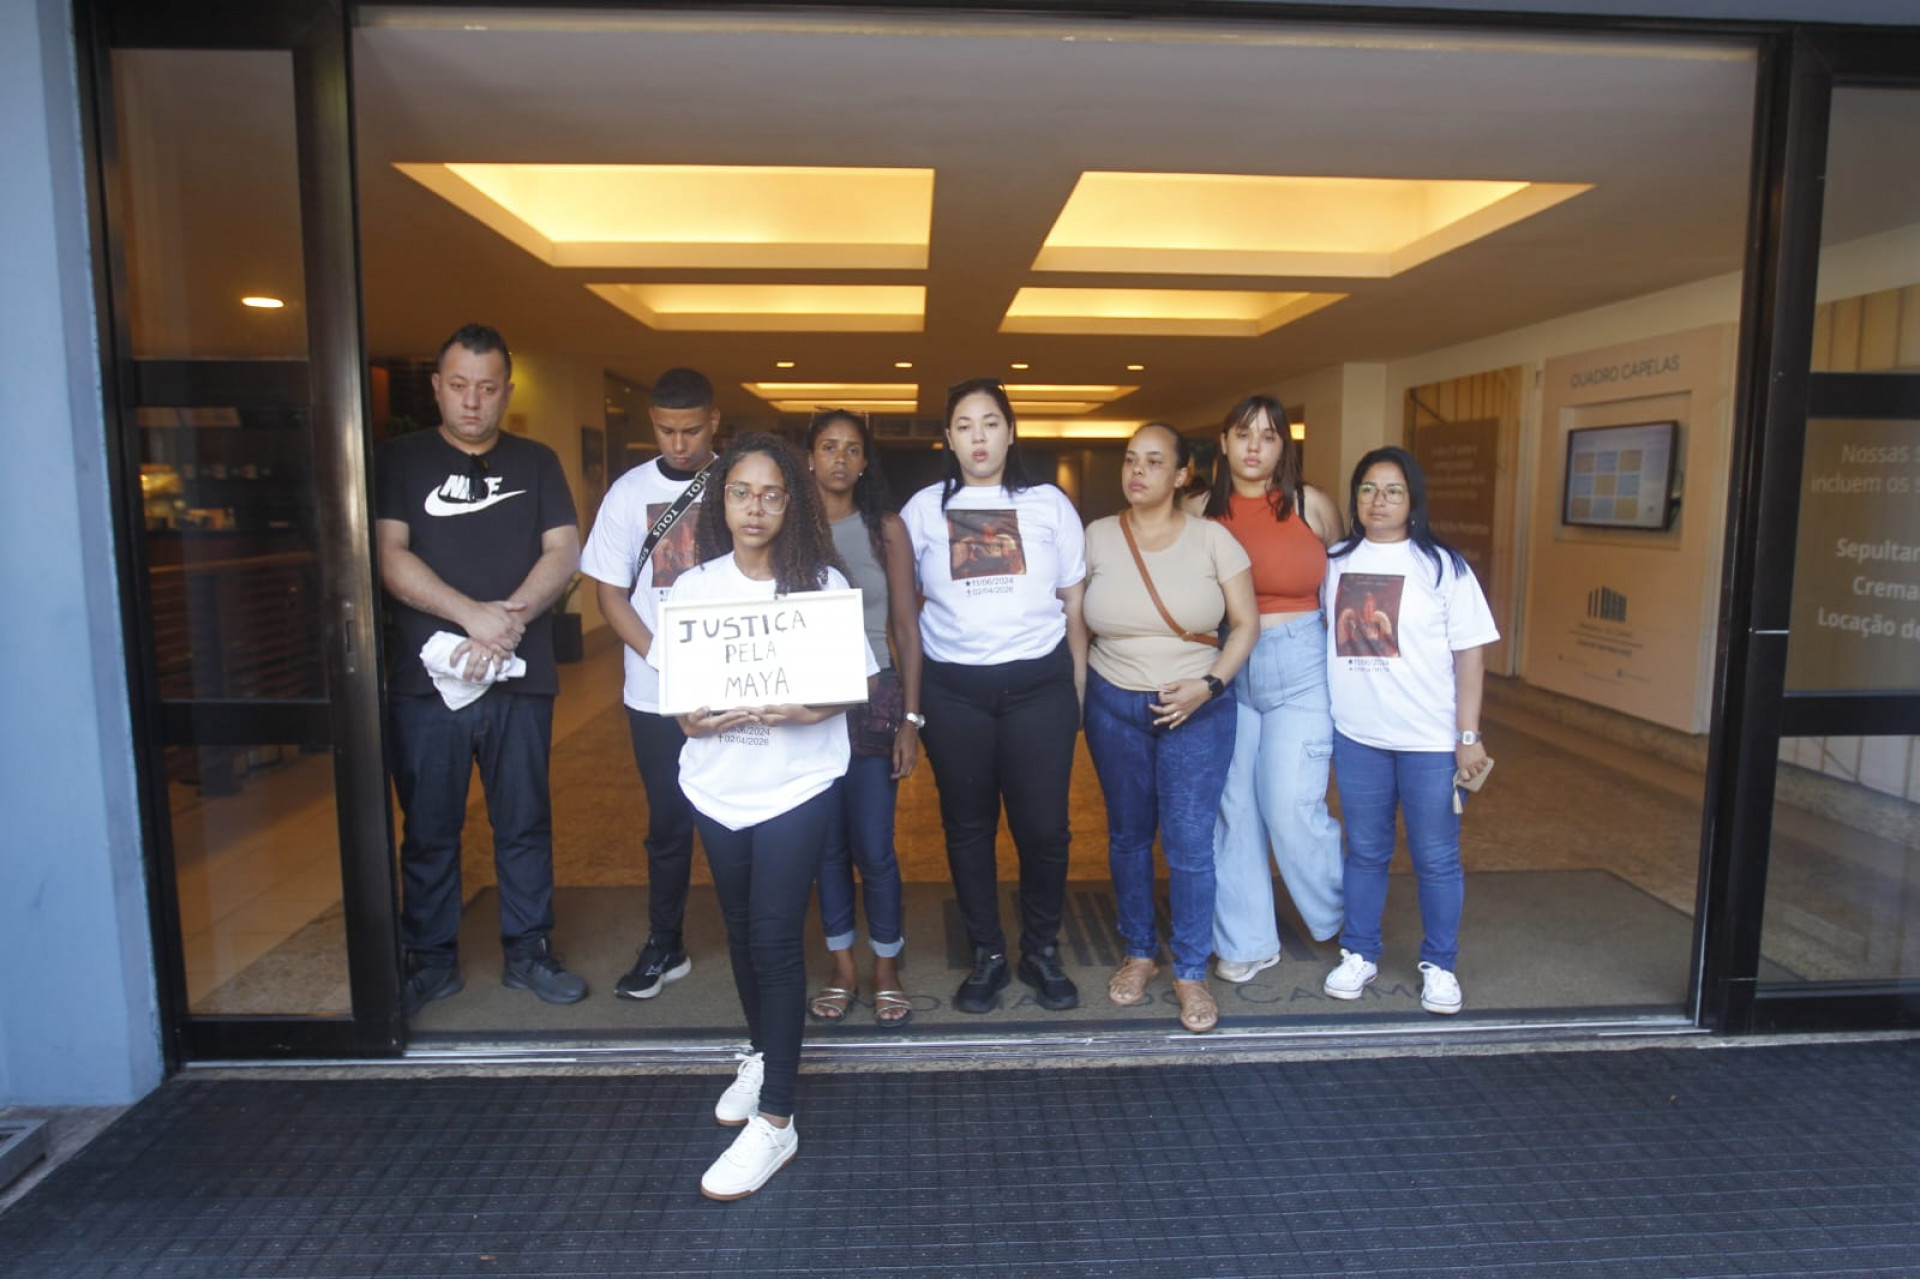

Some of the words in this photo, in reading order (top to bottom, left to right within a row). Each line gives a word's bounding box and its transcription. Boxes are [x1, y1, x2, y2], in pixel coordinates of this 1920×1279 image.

[1570, 364, 1620, 390] QUADRO
[1621, 354, 1681, 379] CAPELAS
[1840, 444, 1910, 464] Nossas
[1811, 471, 1882, 493] incluem
[1886, 476, 1910, 493] os
[652, 508, 680, 538] TOUS
[1817, 606, 1896, 638] Locação
[725, 640, 777, 664] PELA
[724, 667, 790, 699] MAYA
